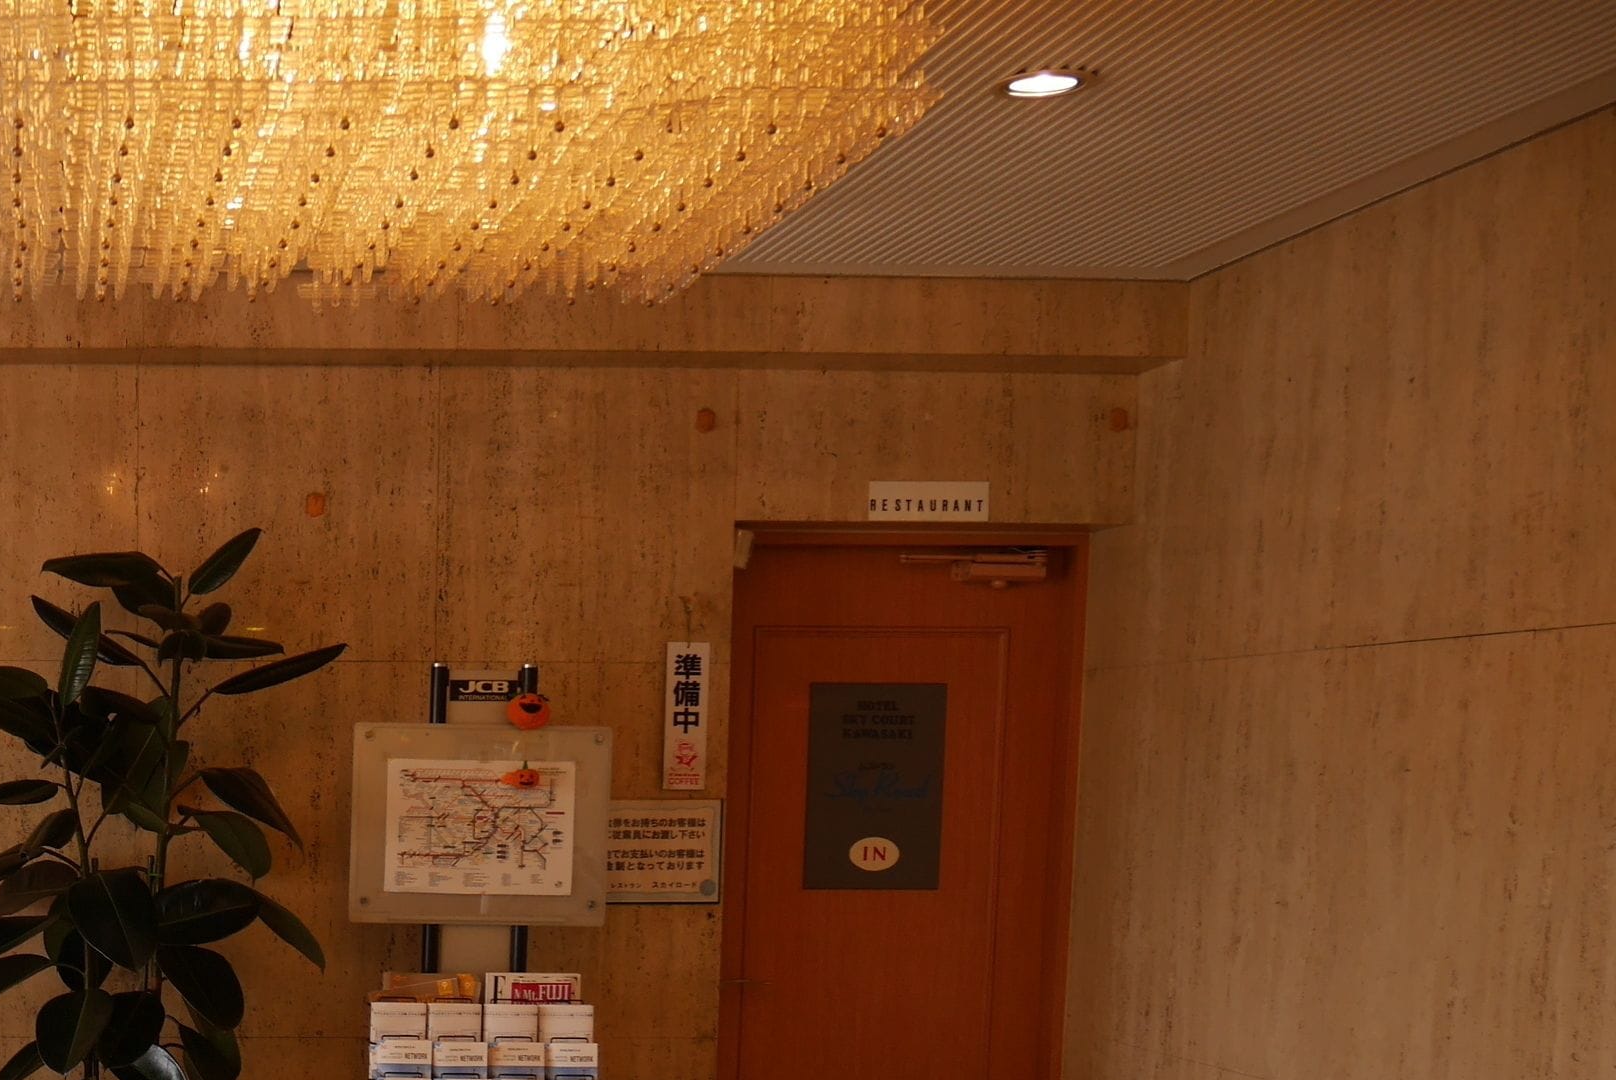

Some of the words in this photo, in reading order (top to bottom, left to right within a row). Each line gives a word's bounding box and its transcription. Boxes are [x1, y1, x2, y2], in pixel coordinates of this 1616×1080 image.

[870, 499, 983, 512] RESTAURANT
[458, 681, 509, 693] JCB
[673, 654, 702, 734] 準備中
[872, 715, 915, 725] COURT
[842, 729, 913, 739] KAWASAKI
[668, 777, 700, 785] COFFEE
[862, 846, 887, 861] IN
[651, 881, 698, 889] スカイロード
[538, 984, 569, 1001] FUJI
[404, 1052, 427, 1060] NETWORK
[517, 1054, 541, 1062] NETWORK
[570, 1055, 594, 1063] NETWORK
